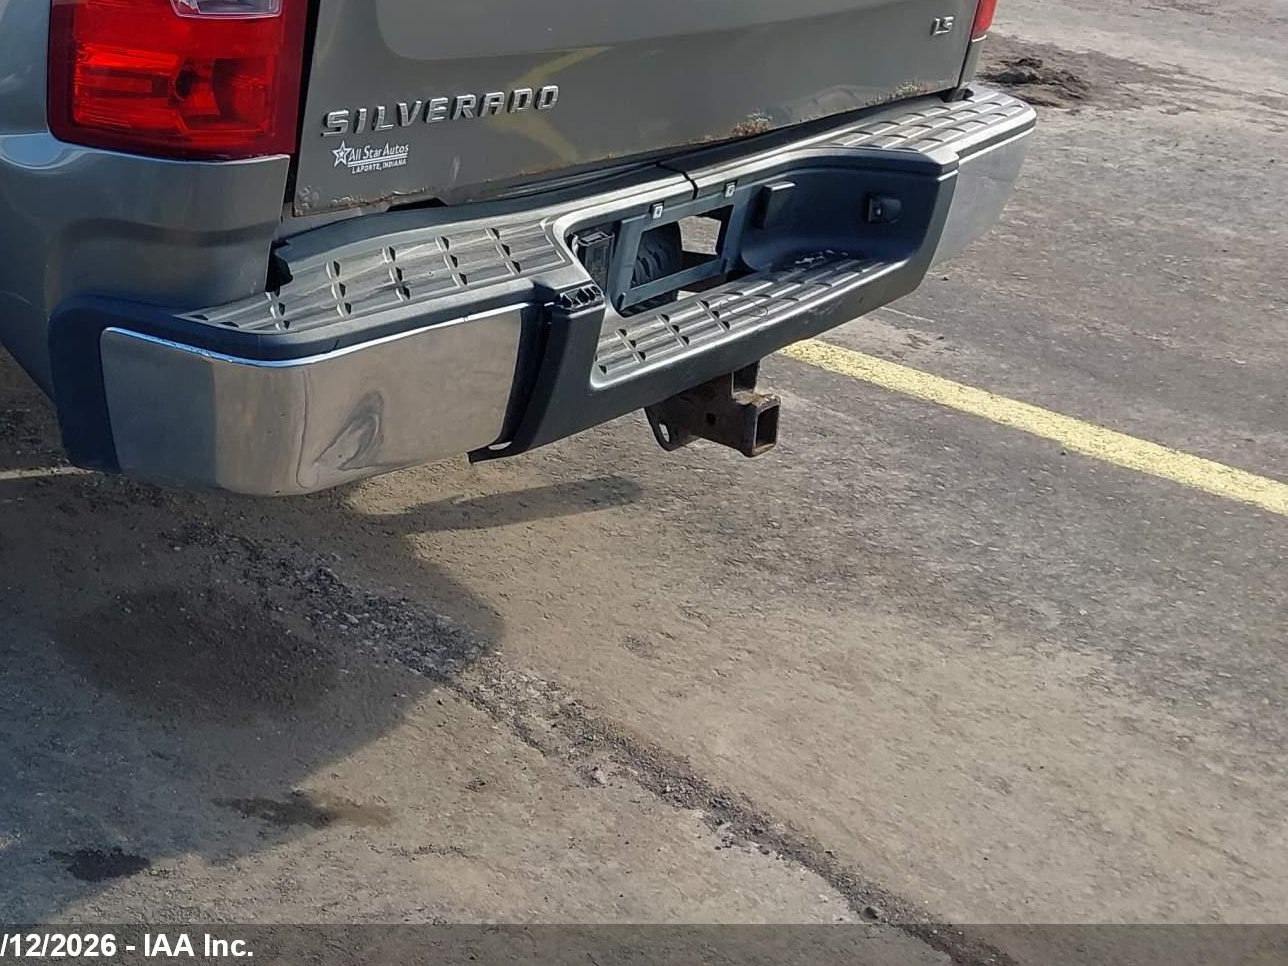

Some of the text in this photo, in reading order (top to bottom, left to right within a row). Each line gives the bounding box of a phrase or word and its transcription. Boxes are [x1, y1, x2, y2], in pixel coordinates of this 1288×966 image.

[321, 85, 560, 137] SILVERADO
[348, 142, 409, 161] All Star Autos
[382, 158, 407, 169] INDIANA
